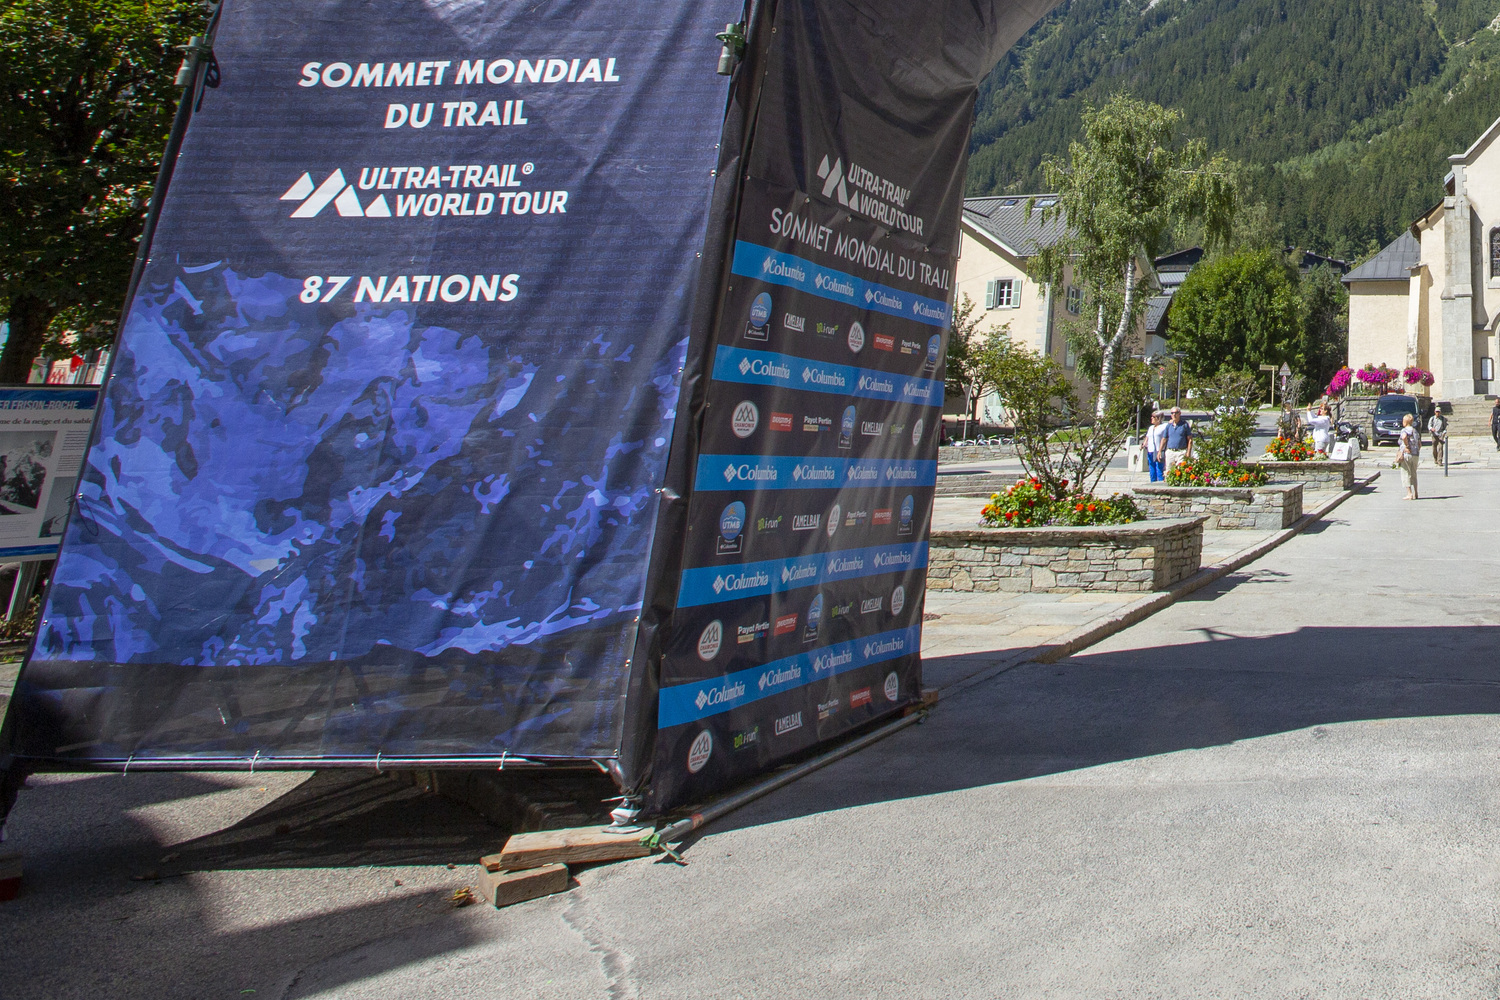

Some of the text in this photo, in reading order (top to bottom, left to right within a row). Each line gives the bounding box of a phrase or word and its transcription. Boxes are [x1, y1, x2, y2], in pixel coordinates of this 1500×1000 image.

[298, 57, 621, 87] SOMMET MONDIAL
[384, 99, 528, 129] DU TRAIL
[395, 190, 569, 217] WORLD TOUR
[860, 193, 924, 237] WORLD TOUR
[769, 207, 949, 290] SOMMET MONDIAL DU TRAIL
[299, 273, 521, 304] 87 NATIONS
[769, 259, 945, 320] Columbia Columbia Columbia Columbia
[750, 359, 791, 379] Columbia
[810, 368, 845, 387] Columbia
[865, 376, 893, 393] Columbia
[11, 401, 79, 410] FRISON-ROCHE
[737, 464, 917, 480] Columbia Columbia Columbia Columbia
[722, 520, 741, 530] UTMB
[792, 514, 820, 531] CAMELBAK
[724, 551, 911, 591] Columbia Columbia Columbia Columbia
[737, 621, 770, 634] Payot Pertin
[707, 637, 904, 705] Columbia Columbia Columbia Columbia
[775, 711, 803, 736] CAMELBAK
